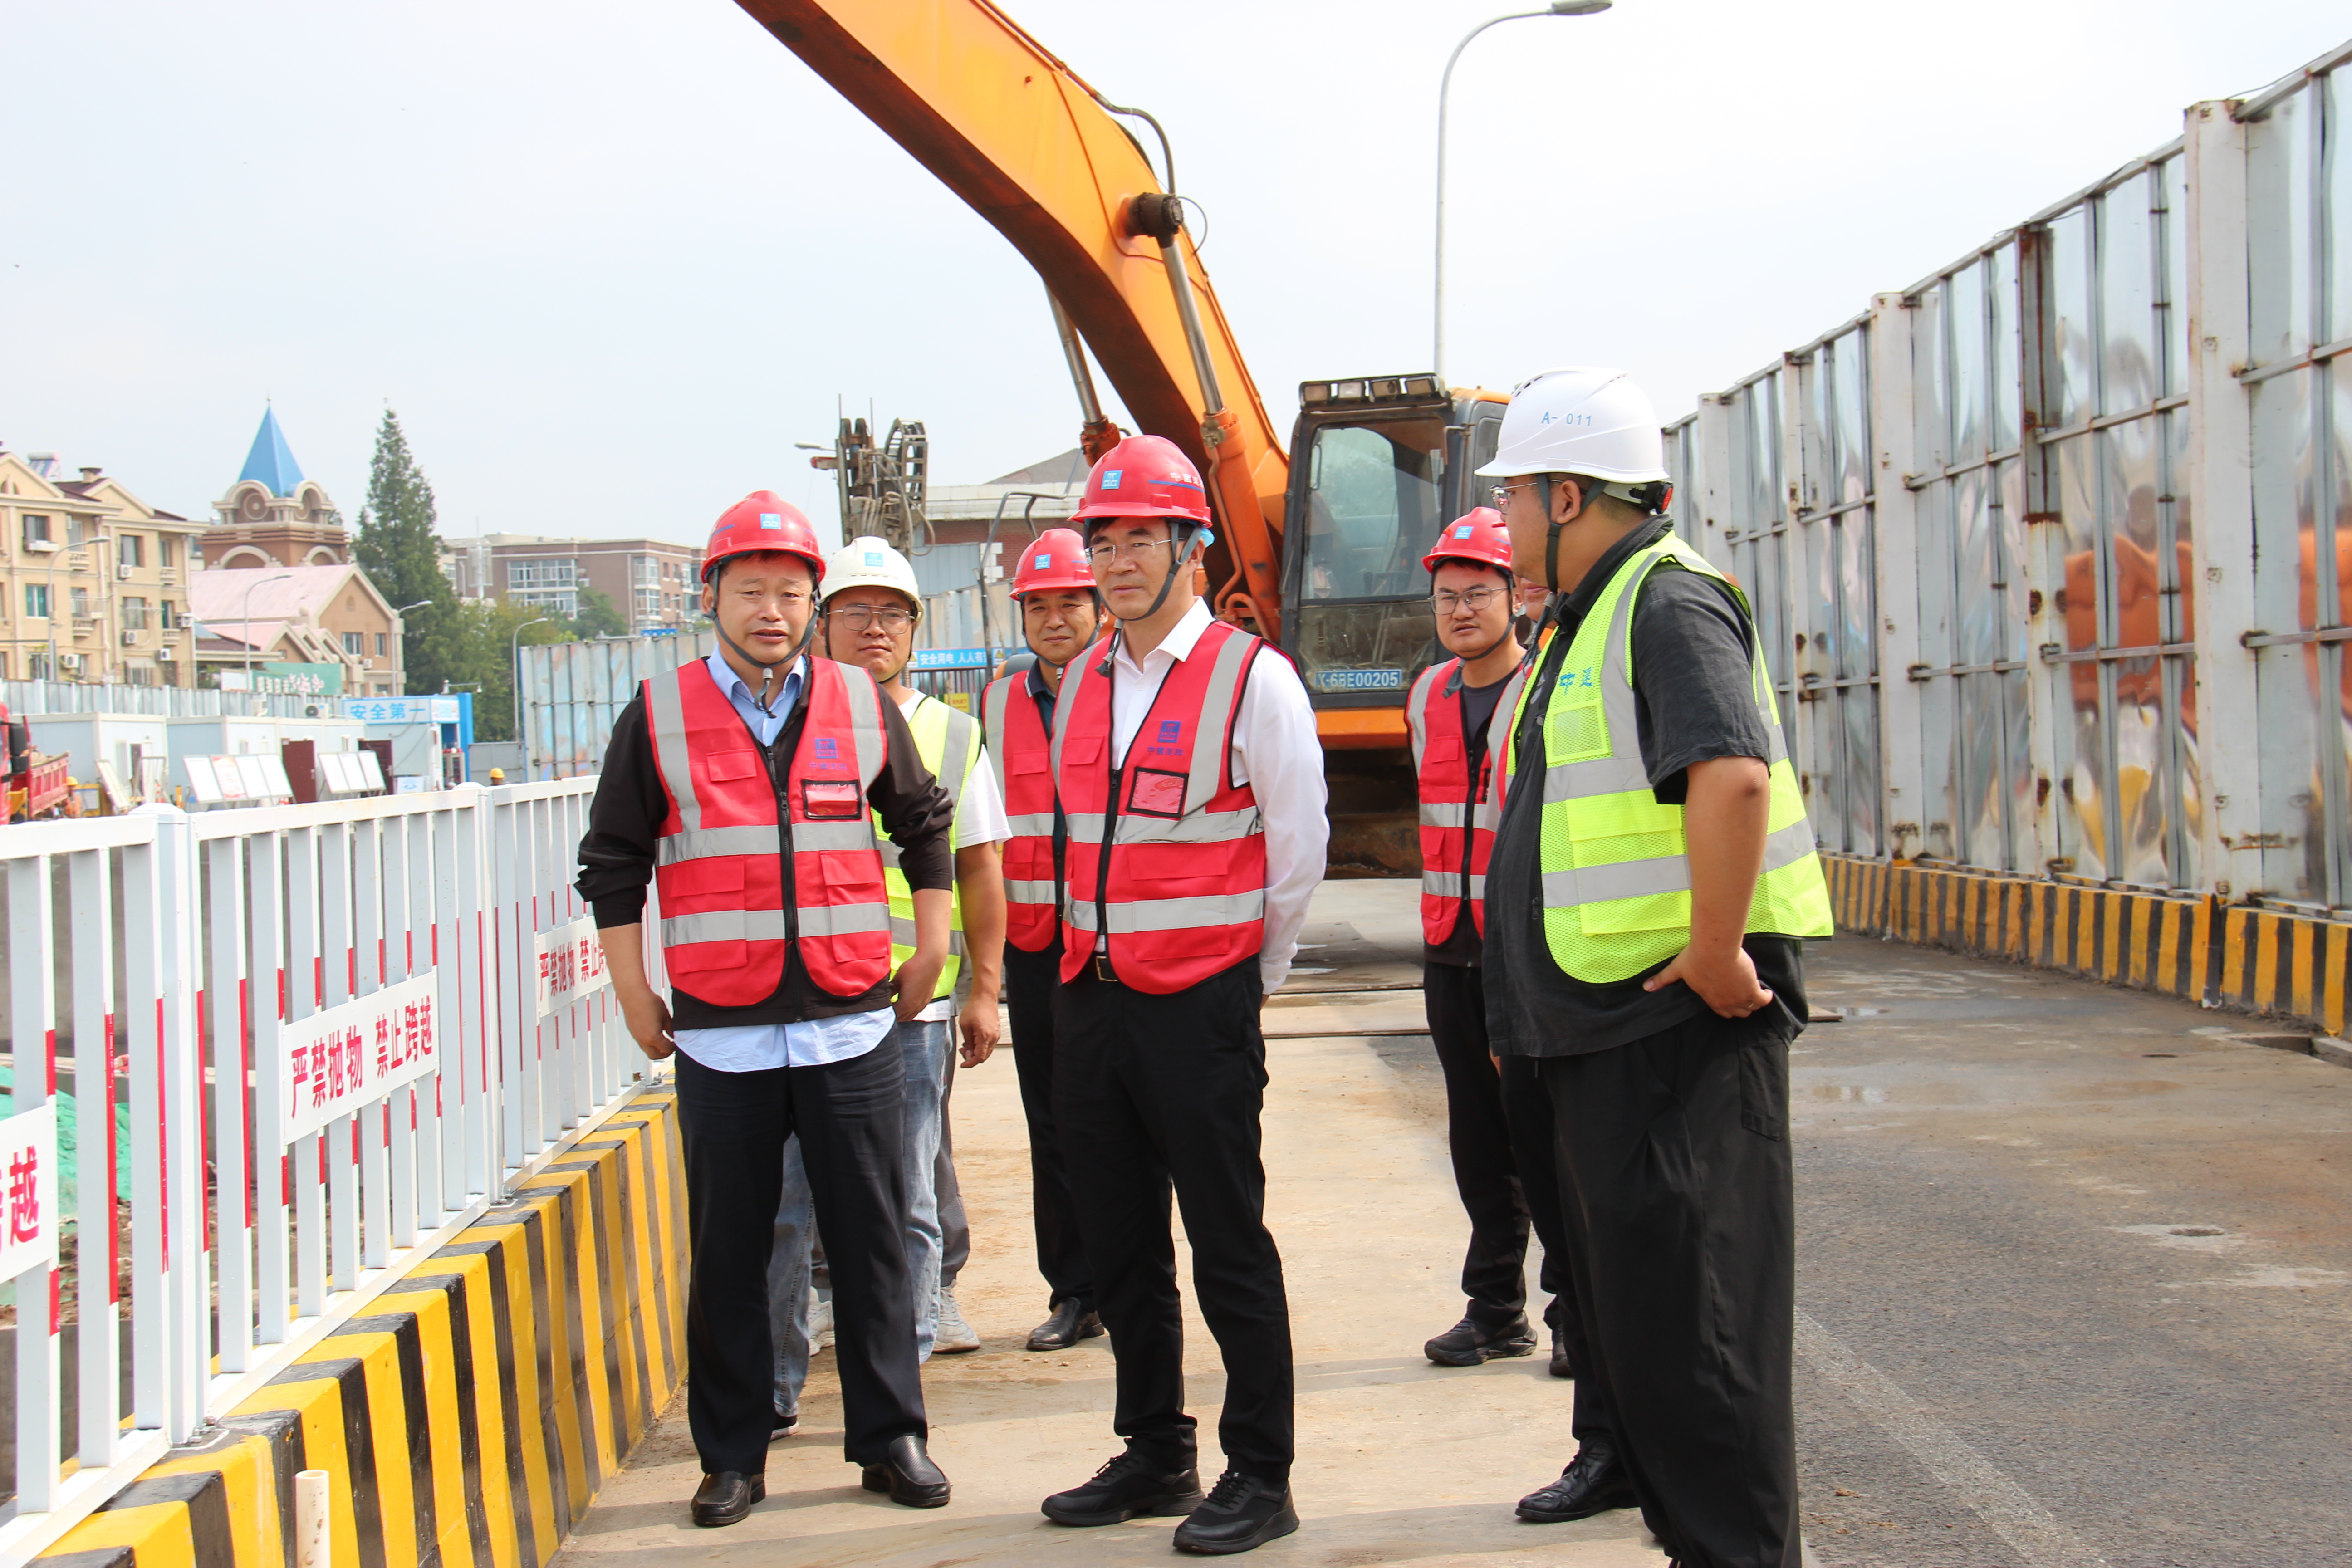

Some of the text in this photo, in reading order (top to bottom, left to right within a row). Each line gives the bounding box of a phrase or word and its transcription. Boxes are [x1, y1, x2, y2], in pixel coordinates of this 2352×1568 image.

[920, 652, 955, 665] 安全用电
[350, 703, 426, 720] 安全第一
[539, 941, 576, 1002] 严禁抛物
[291, 995, 433, 1120] 严禁抛物 禁止跨越
